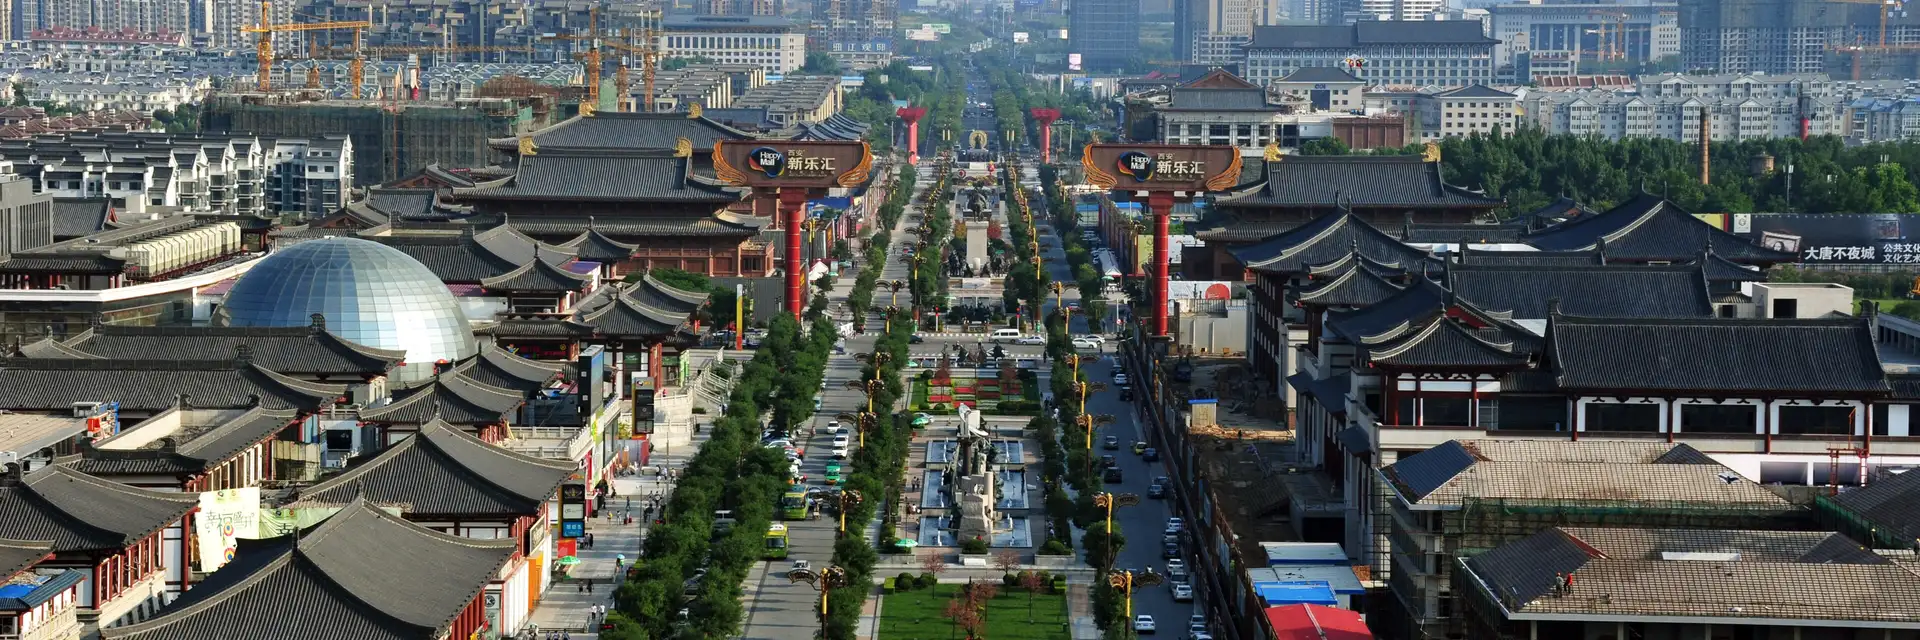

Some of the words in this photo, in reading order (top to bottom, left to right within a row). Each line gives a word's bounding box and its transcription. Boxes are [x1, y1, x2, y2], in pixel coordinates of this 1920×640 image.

[760, 152, 781, 160] Happy
[1130, 156, 1151, 164] Happy
[1157, 152, 1173, 160] 西安
[760, 158, 775, 166] Mall
[787, 157, 836, 171] 新乐汇
[1130, 162, 1145, 170] Mall
[1156, 160, 1205, 174] 新乐汇
[1883, 243, 1920, 253] 公共文化
[1804, 246, 1875, 260] 大唐不夜城
[1883, 253, 1920, 263] 文化艺术
